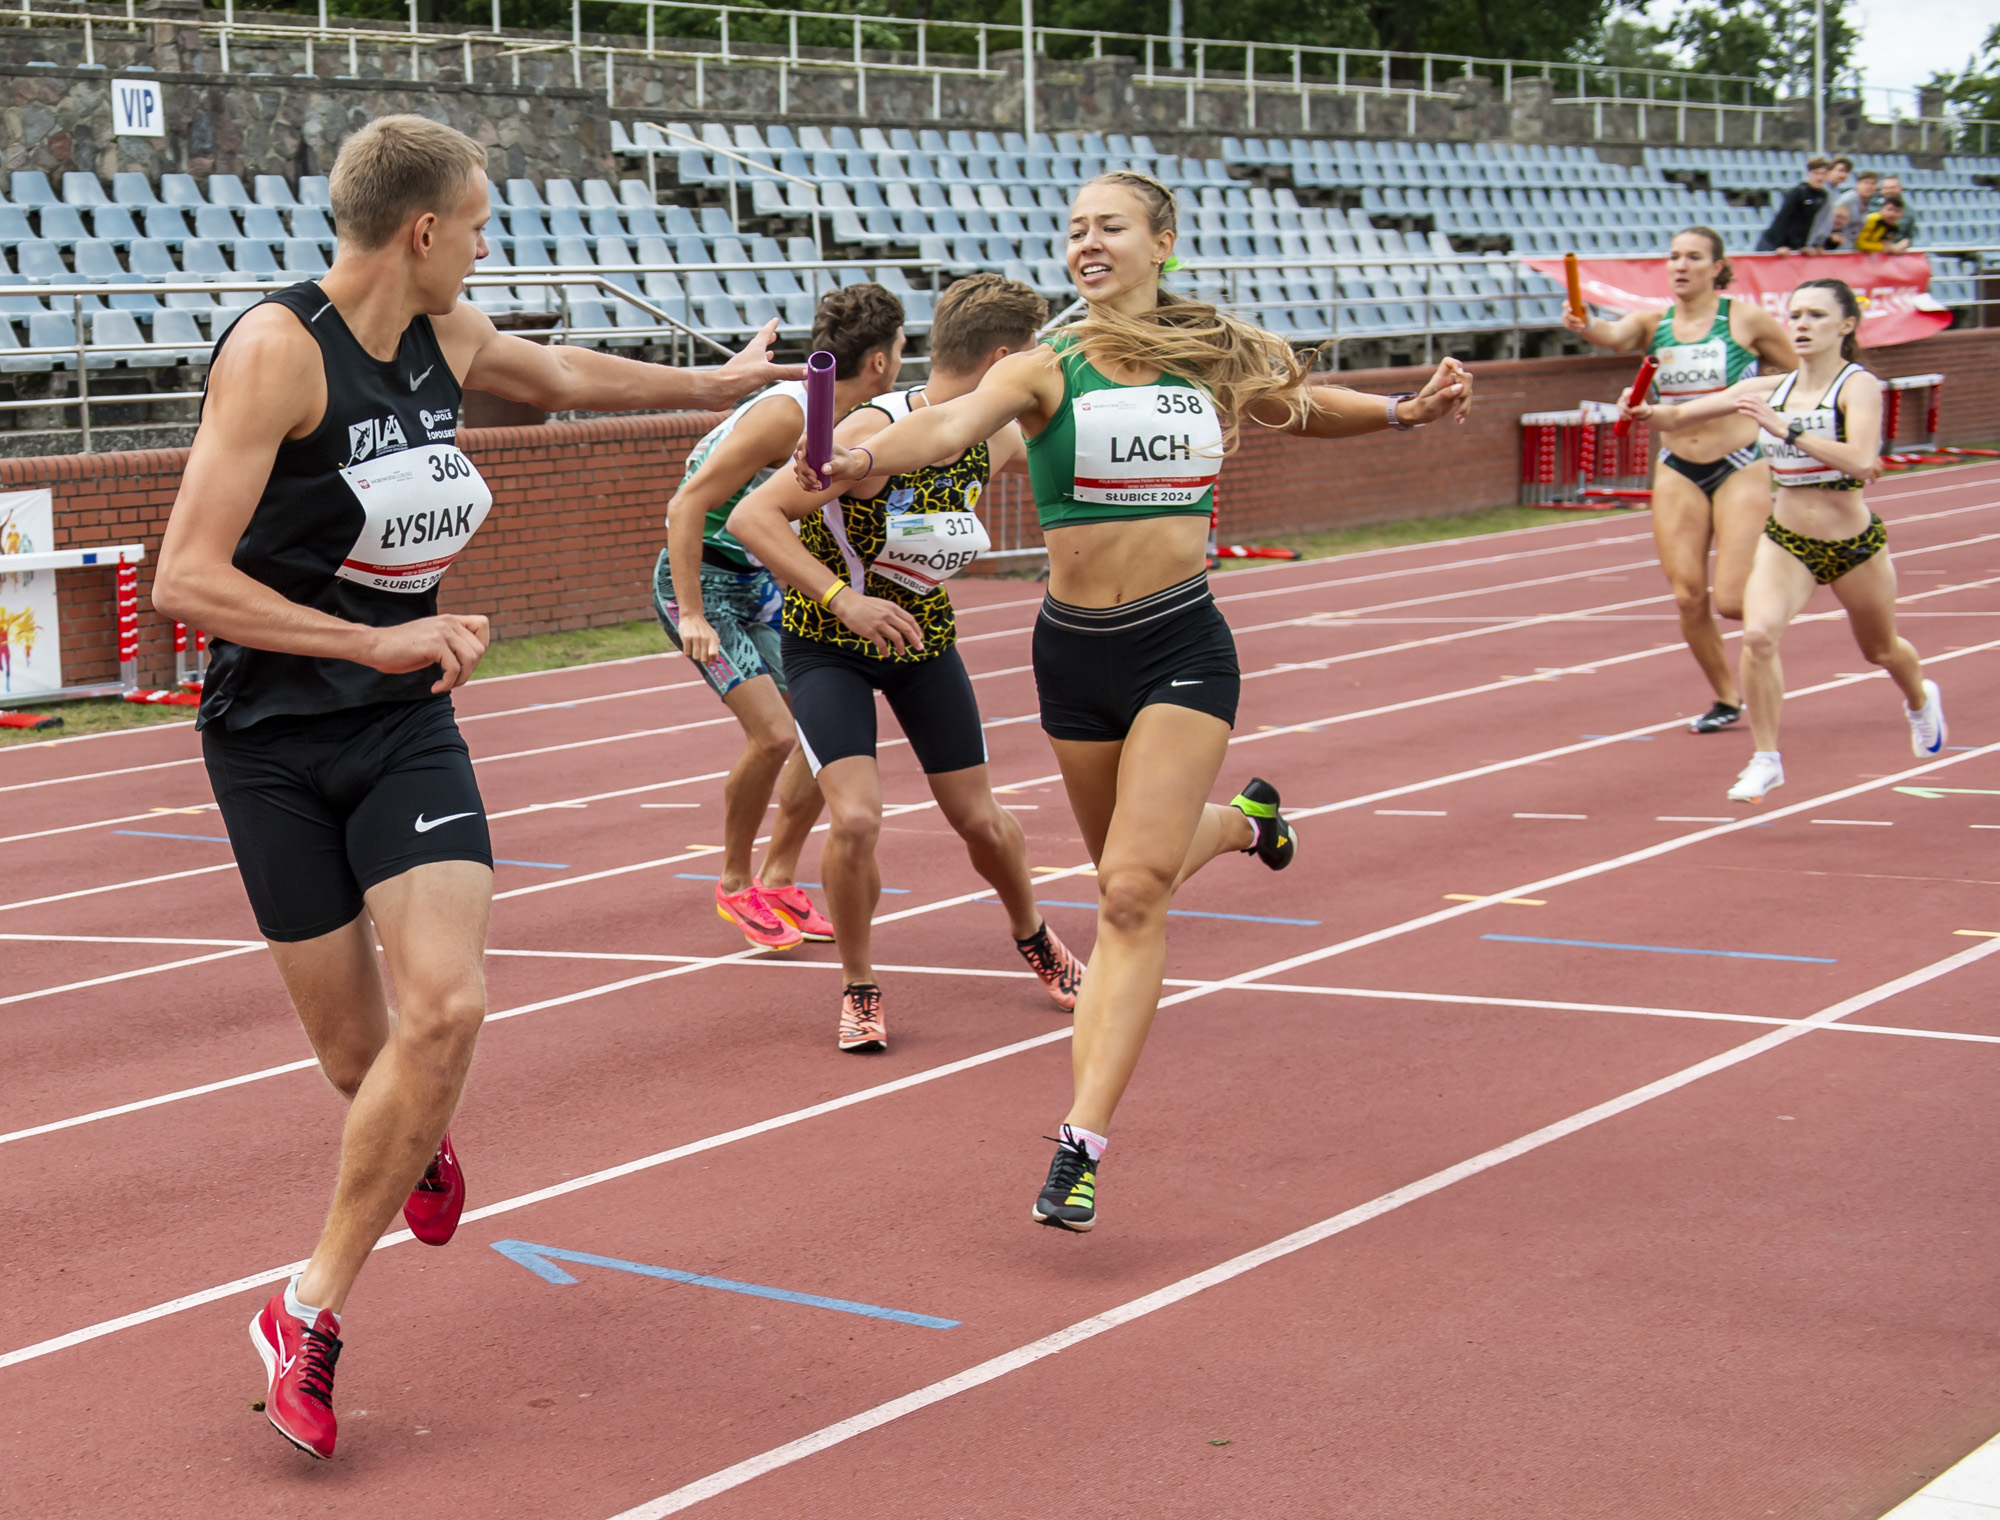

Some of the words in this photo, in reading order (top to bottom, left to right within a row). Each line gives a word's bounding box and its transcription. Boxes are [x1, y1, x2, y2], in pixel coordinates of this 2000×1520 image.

[121, 87, 154, 128] VIP
[1691, 348, 1719, 360] 266
[1659, 368, 1720, 386] SŁOCKA
[1156, 393, 1203, 415] 358
[433, 411, 453, 422] OPOLE
[1110, 434, 1191, 463] LACH
[428, 453, 471, 482] 360
[1105, 492, 1158, 502] SŁUBICE
[1160, 491, 1192, 501] 2024
[380, 503, 474, 549] ŁYSIAK
[946, 517, 975, 536] 317
[372, 577, 428, 590] SŁUBICE
